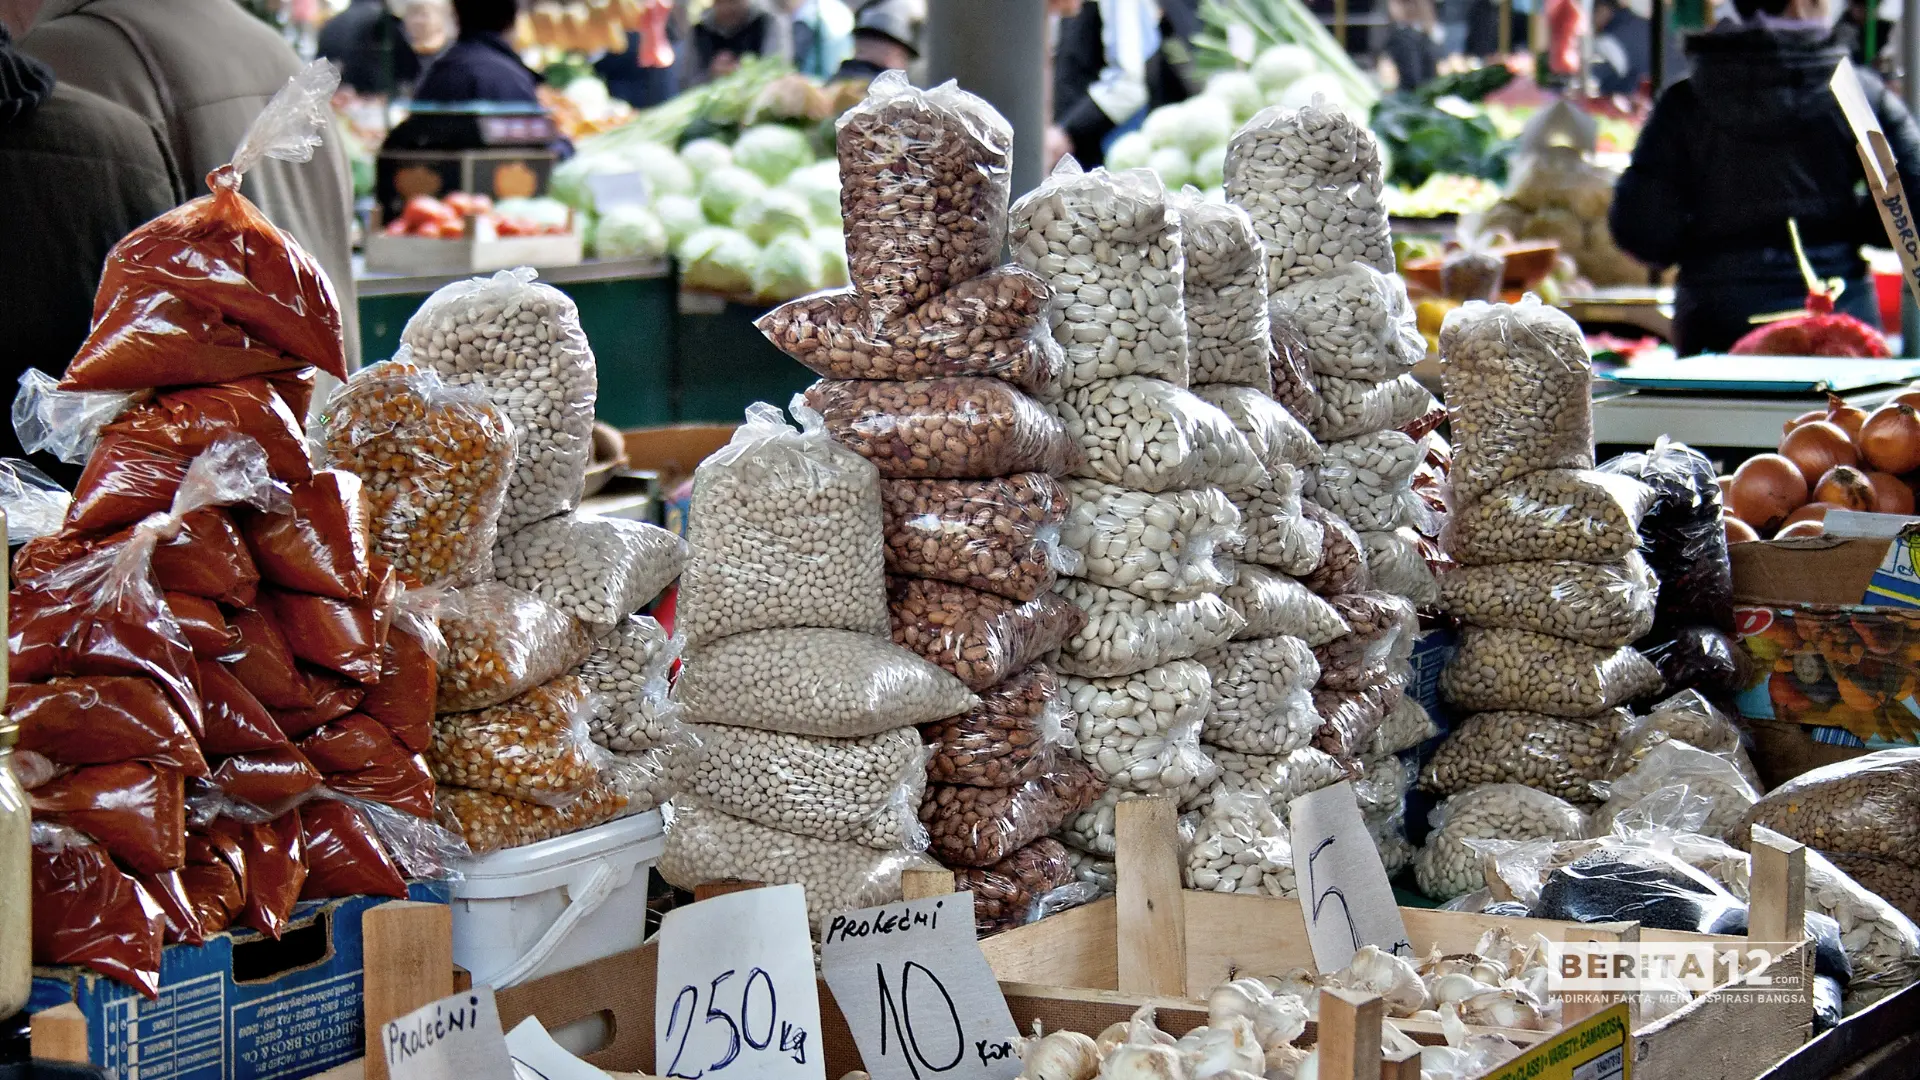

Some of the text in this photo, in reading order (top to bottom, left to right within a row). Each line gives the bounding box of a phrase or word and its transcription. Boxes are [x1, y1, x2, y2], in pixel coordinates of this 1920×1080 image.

[1309, 835, 1363, 951] 5
[271, 1035, 302, 1055] BROS
[665, 966, 778, 1080] 250
[876, 959, 966, 1080] 10
